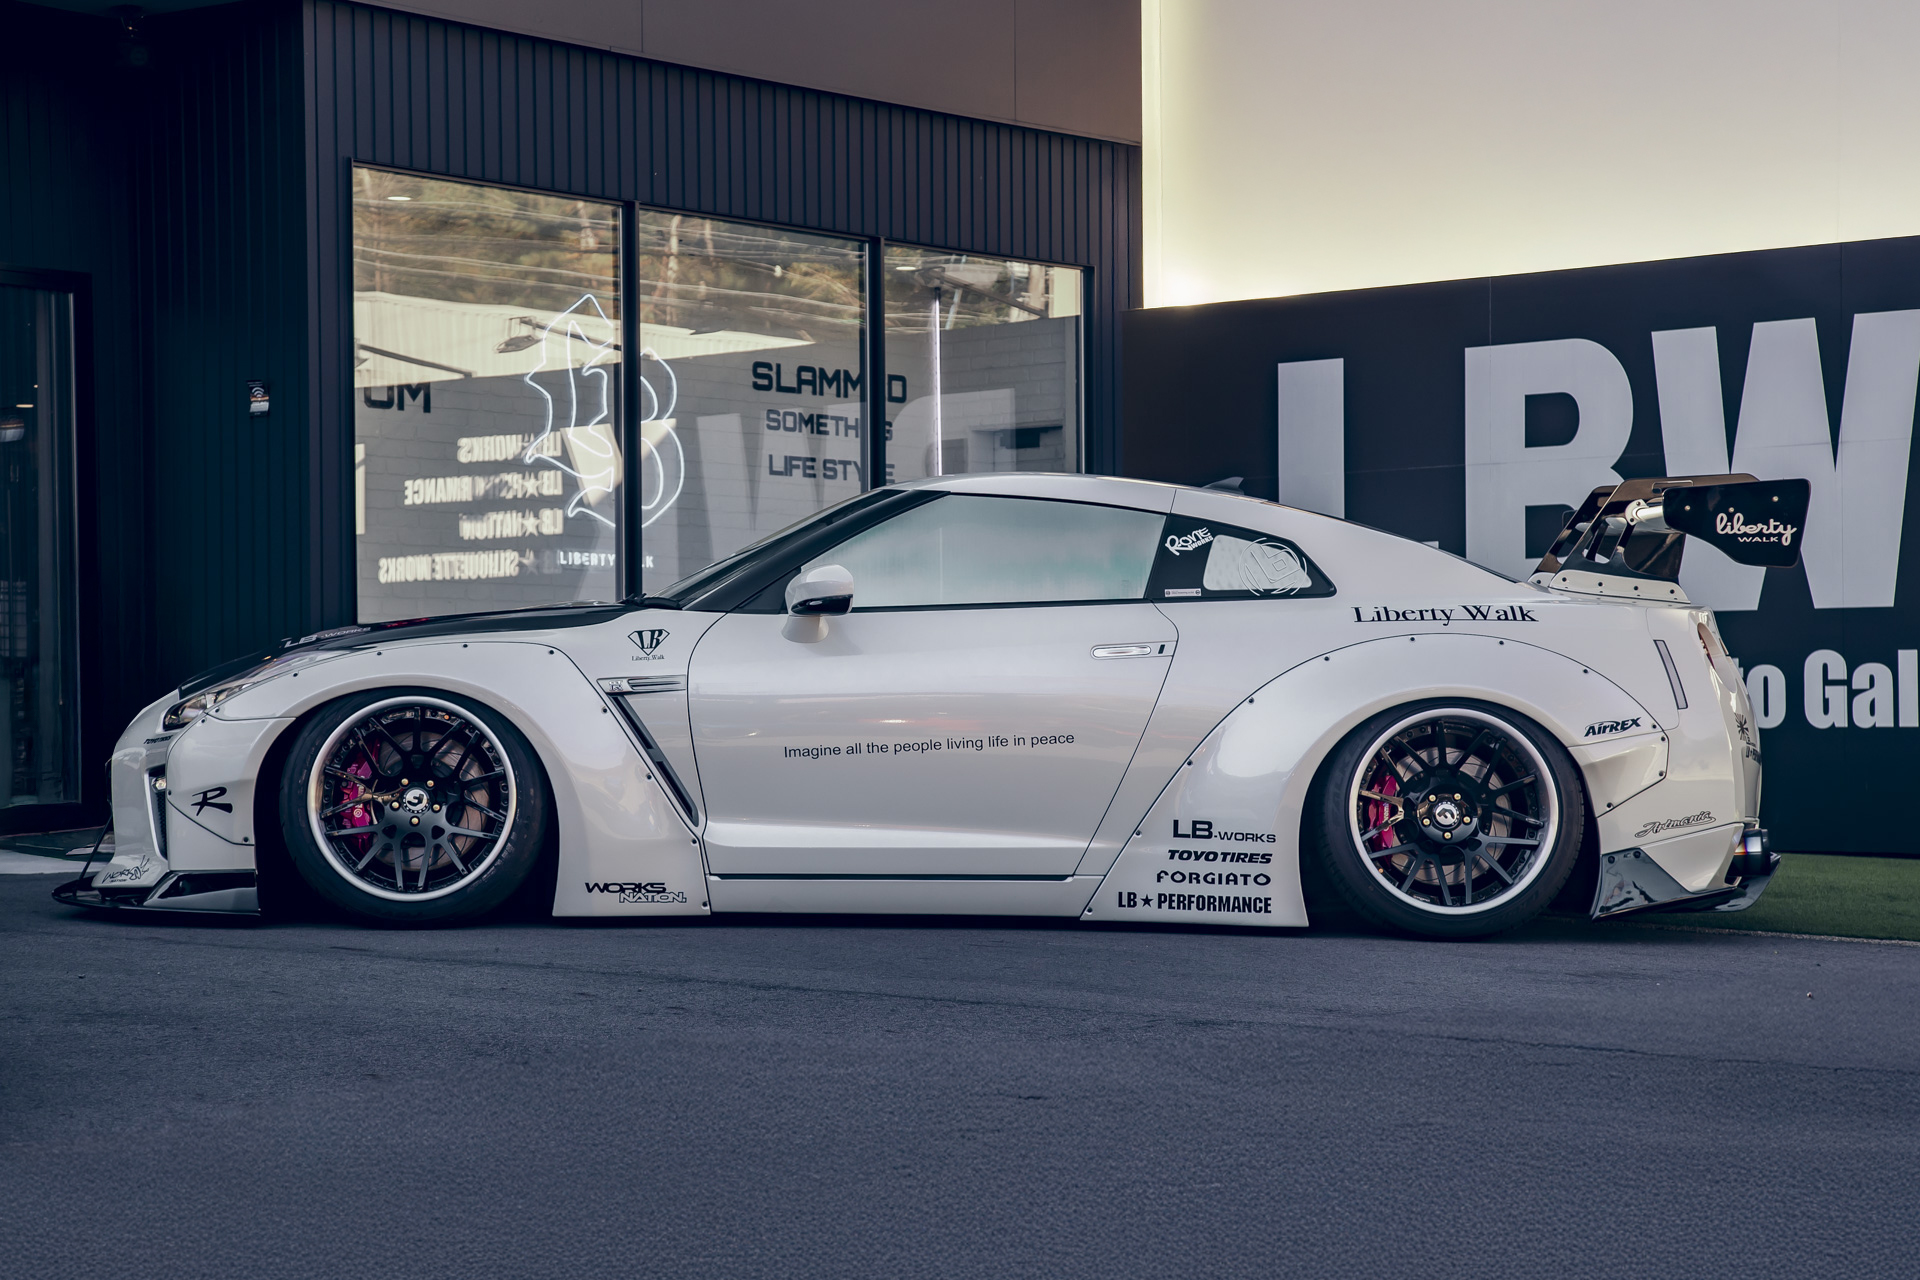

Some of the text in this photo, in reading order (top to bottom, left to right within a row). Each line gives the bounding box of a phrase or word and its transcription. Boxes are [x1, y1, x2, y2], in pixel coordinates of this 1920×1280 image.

[752, 361, 907, 404] SLAMMD
[766, 409, 893, 441] SOMETHG
[769, 454, 895, 484] LIFE STYE
[1716, 513, 1797, 546] liberty
[560, 551, 616, 566] LIBERTY
[1351, 605, 1539, 626] Liberty Walk
[1804, 649, 1919, 729] Gal
[784, 733, 1075, 759] Imagine all the people living life in peace
[191, 787, 233, 816] R
[585, 882, 667, 893] WORKS
[1156, 870, 1271, 886] FORGIATO
[1118, 891, 1272, 913] LB PERFORMANCE
